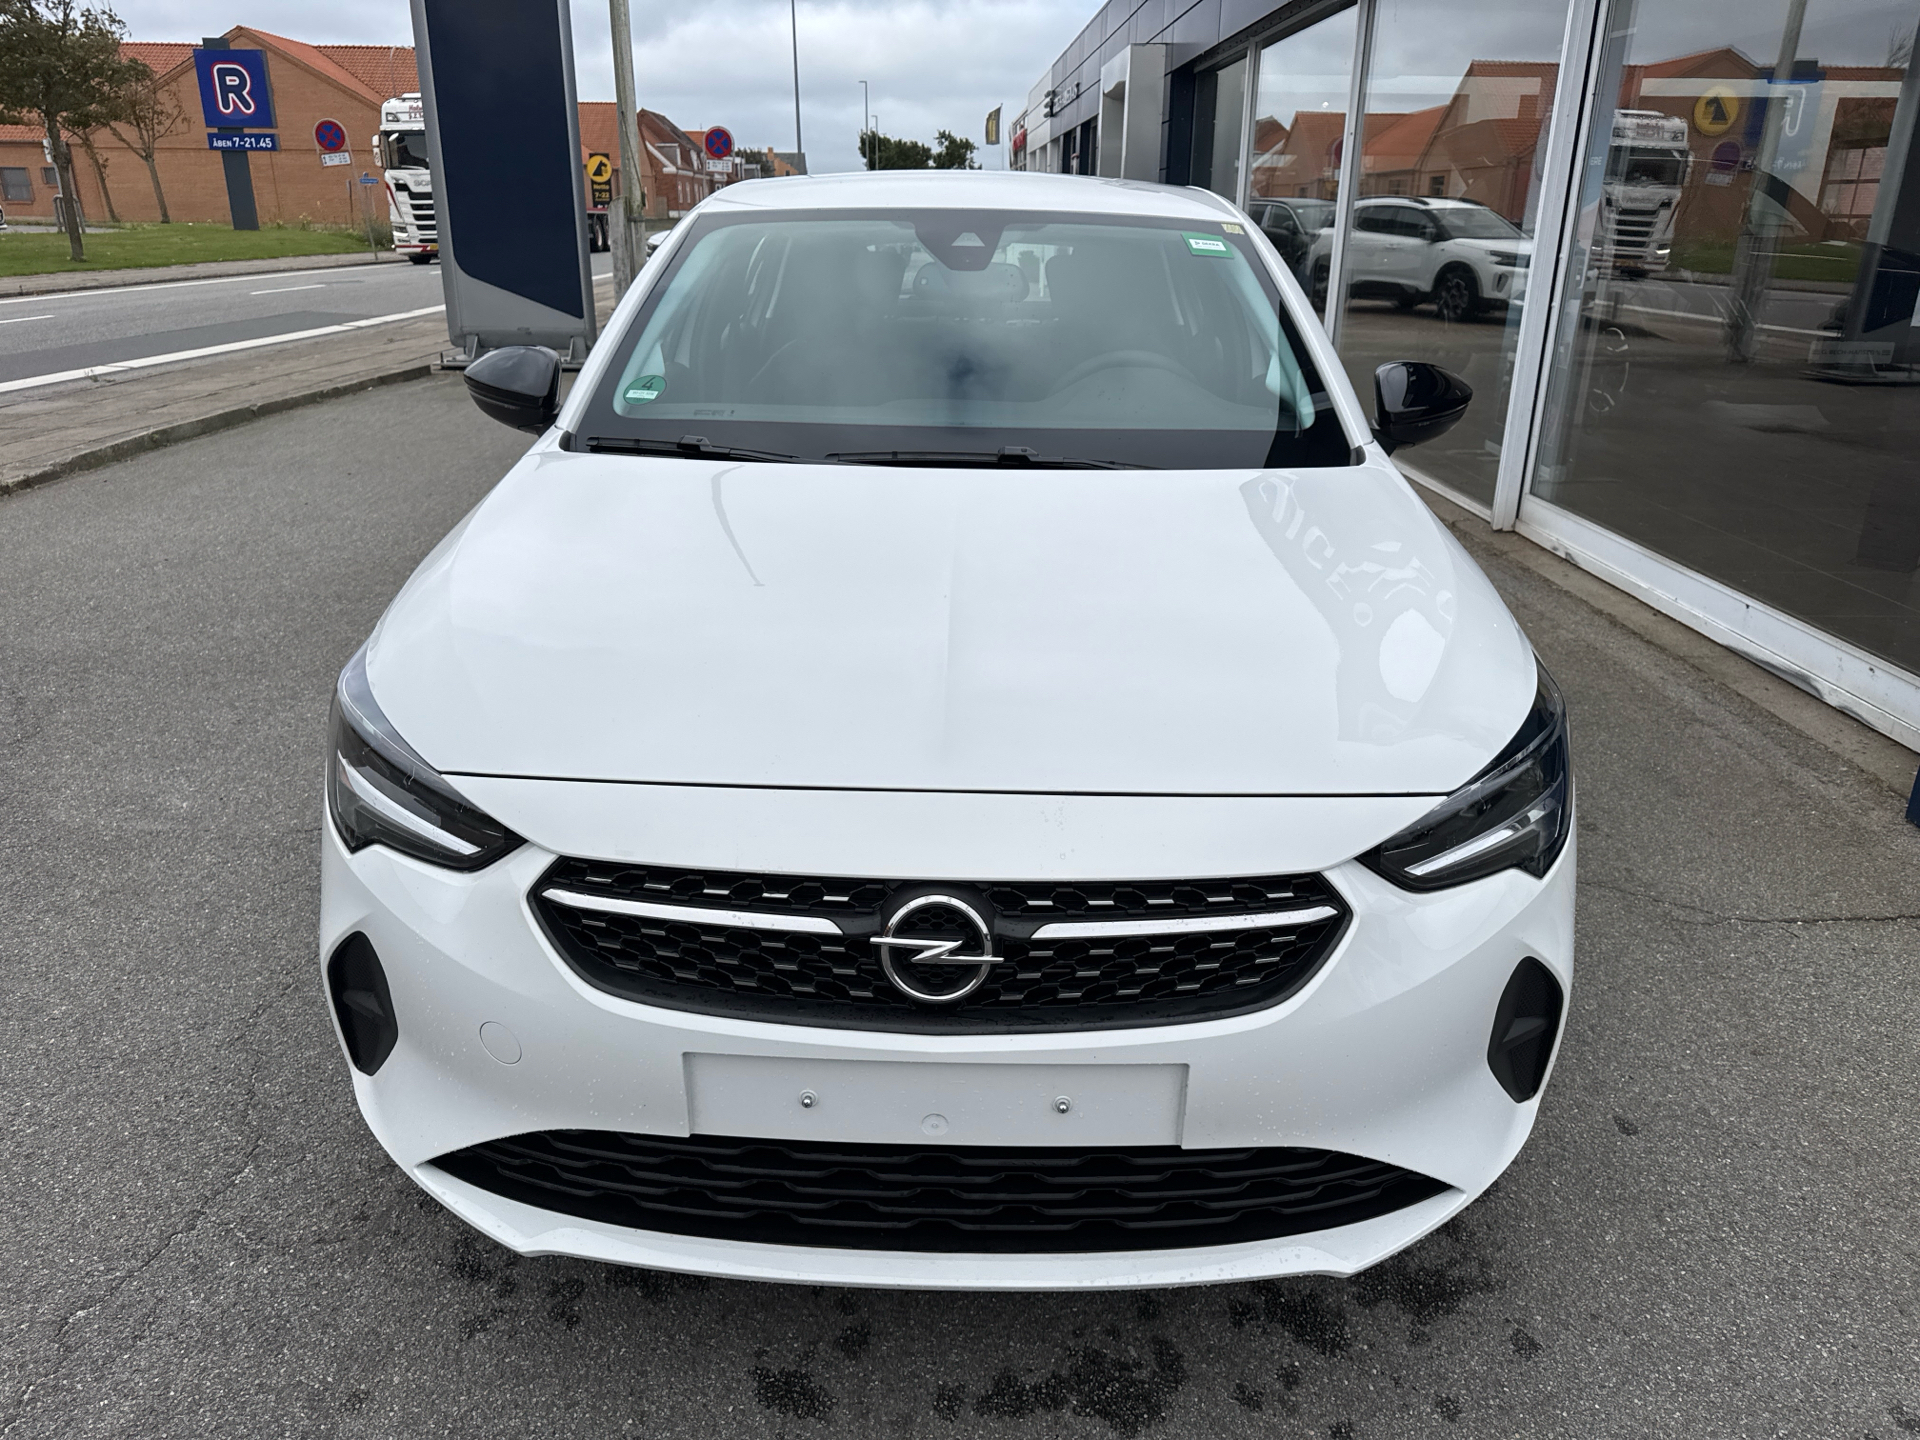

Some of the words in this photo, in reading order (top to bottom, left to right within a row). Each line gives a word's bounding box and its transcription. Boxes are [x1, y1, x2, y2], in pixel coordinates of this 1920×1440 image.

[212, 62, 256, 115] R
[212, 138, 232, 148] ÅBEN
[232, 137, 272, 148] 7-21.45
[641, 376, 656, 391] 4
